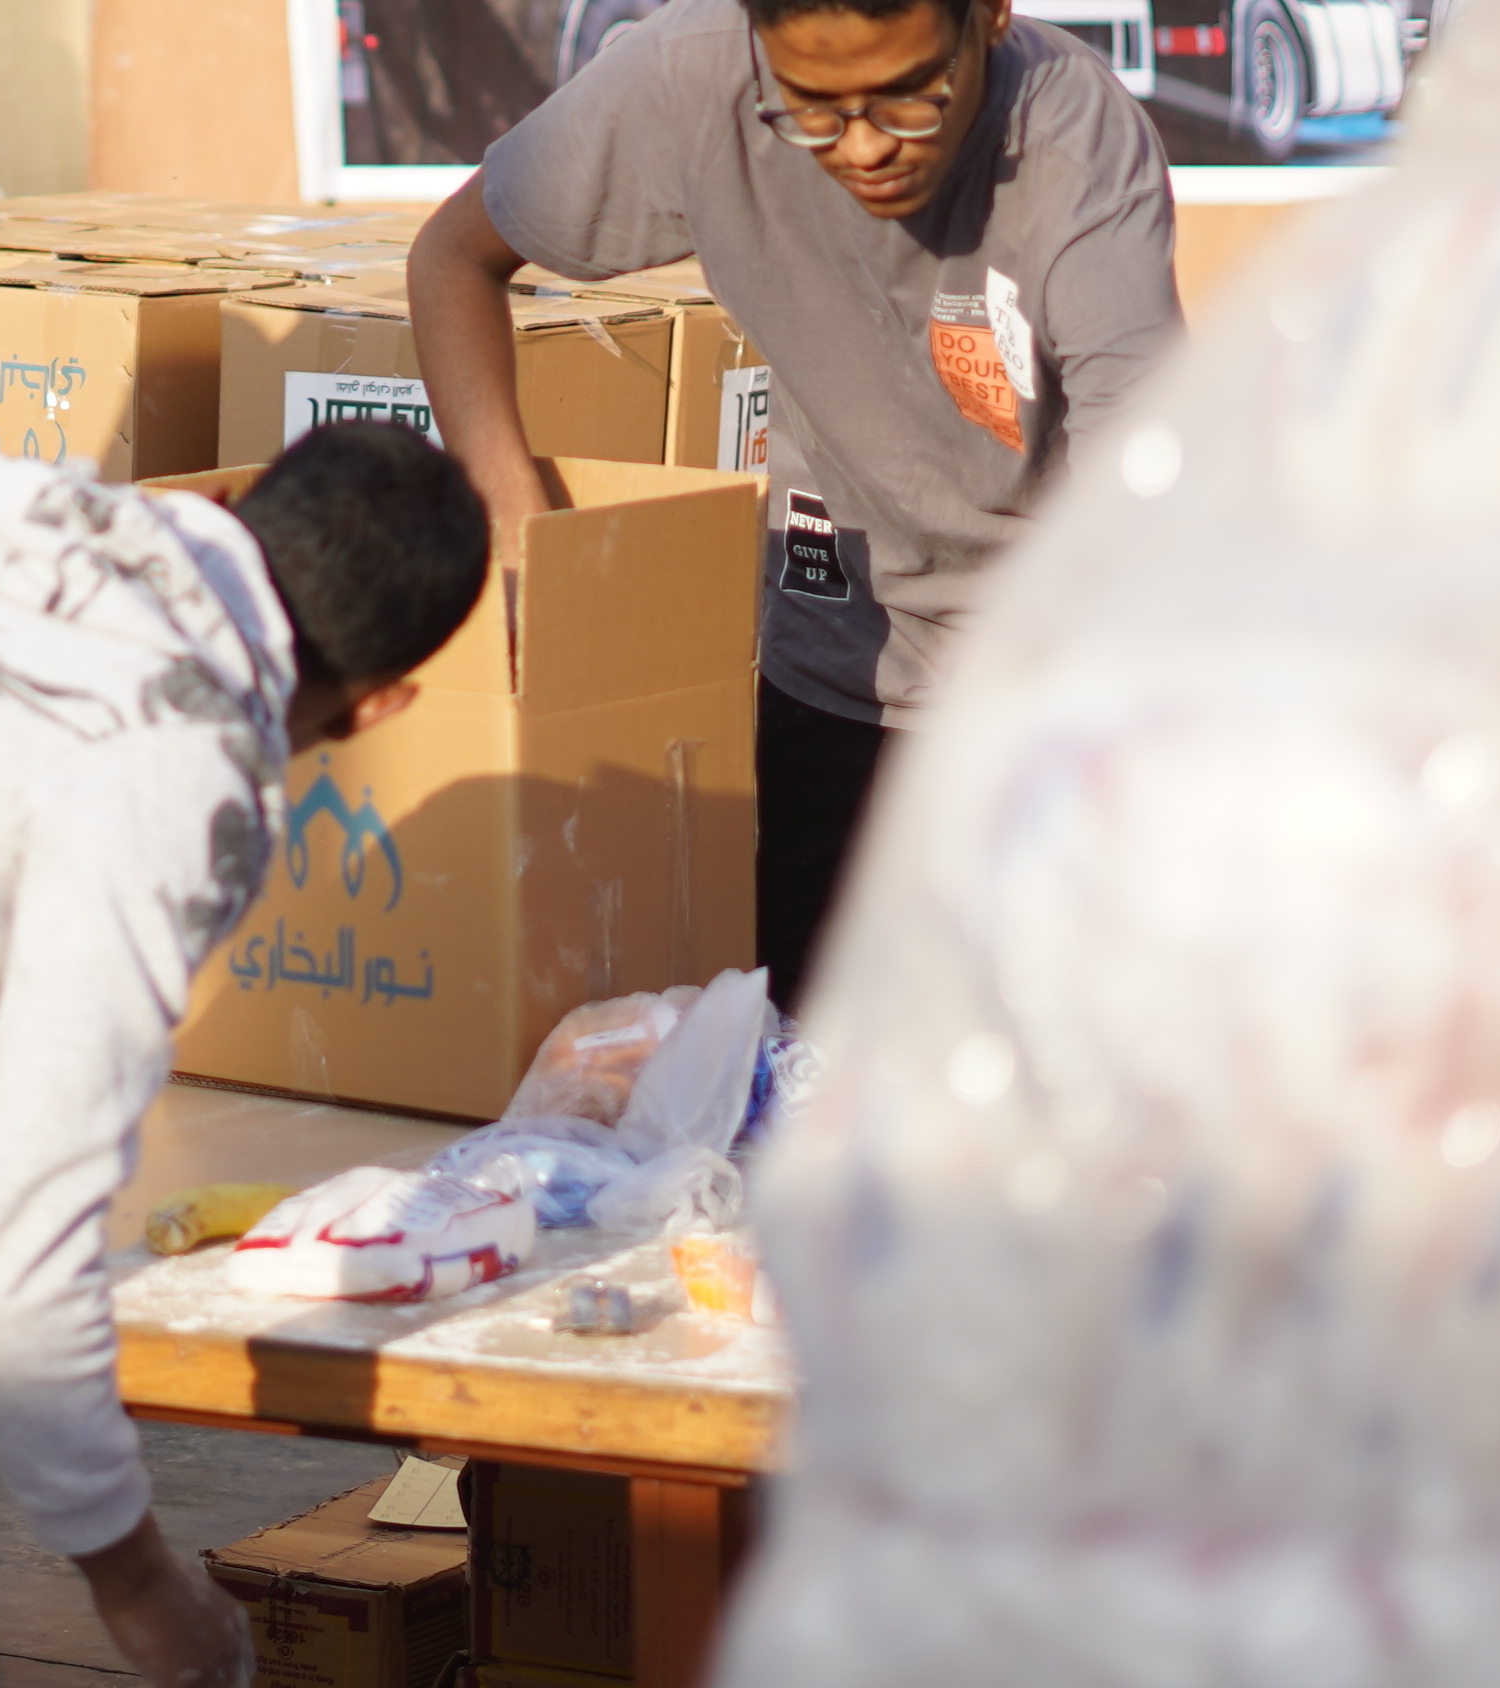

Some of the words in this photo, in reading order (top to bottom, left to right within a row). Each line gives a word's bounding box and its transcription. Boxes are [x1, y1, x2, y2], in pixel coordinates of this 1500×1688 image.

[939, 332, 976, 354] DO
[941, 350, 1009, 382] YOUR
[948, 370, 1006, 404] BEST
[789, 510, 834, 534] NEVER
[792, 544, 830, 562] GIVE
[805, 566, 828, 583] UP
[229, 916, 356, 997] البخاري
[362, 949, 433, 1006] نور
